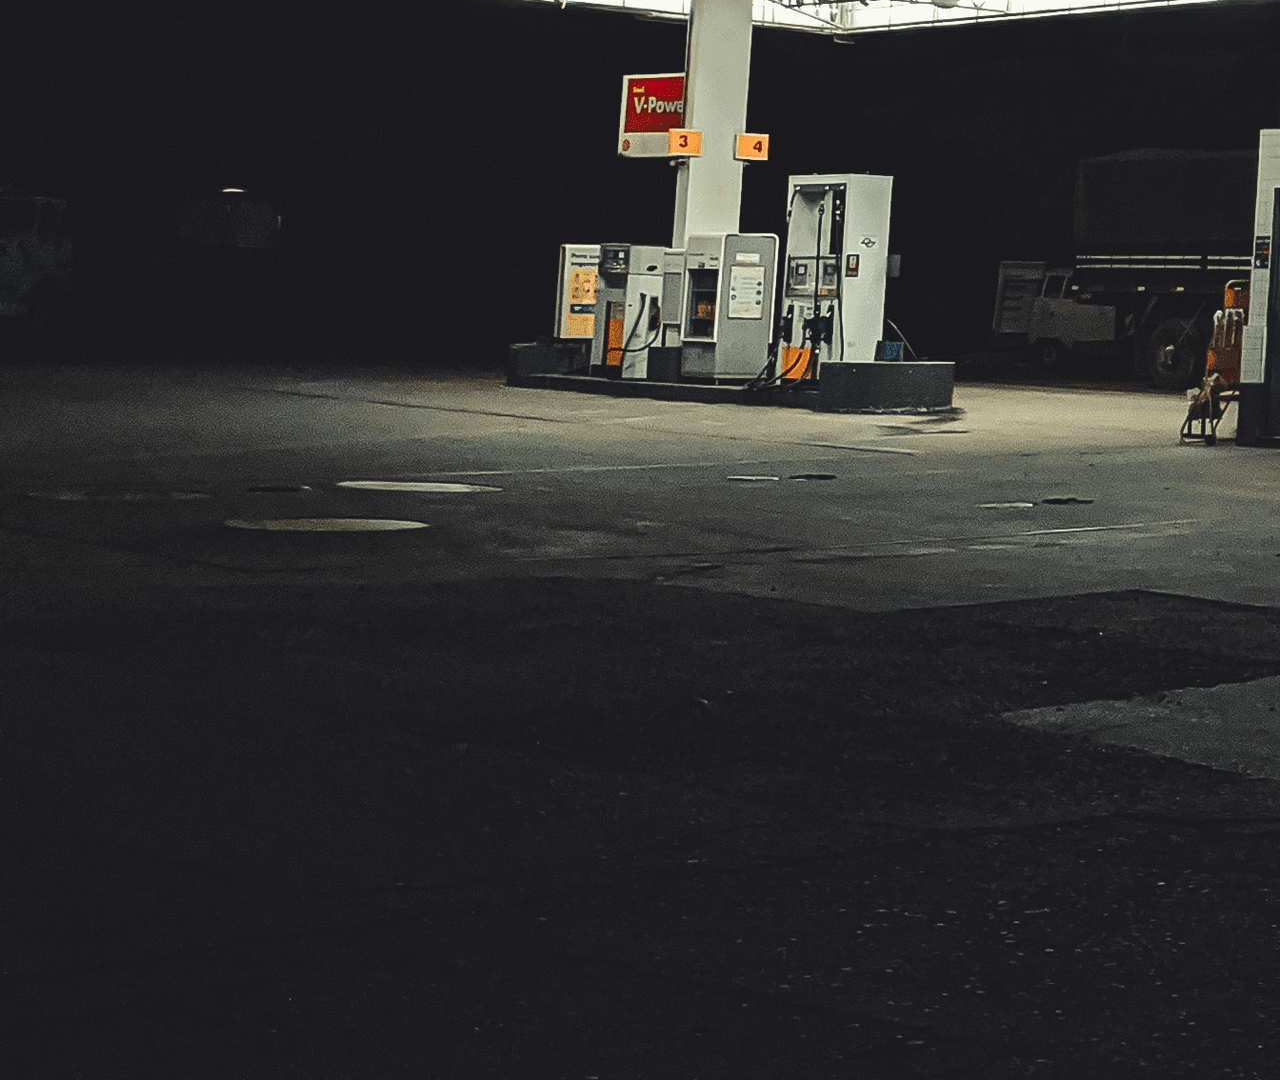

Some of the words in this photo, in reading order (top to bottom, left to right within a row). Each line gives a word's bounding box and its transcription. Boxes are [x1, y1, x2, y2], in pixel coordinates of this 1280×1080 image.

[633, 96, 684, 115] V-Powe
[679, 135, 688, 148] 3
[753, 141, 763, 153] 4
